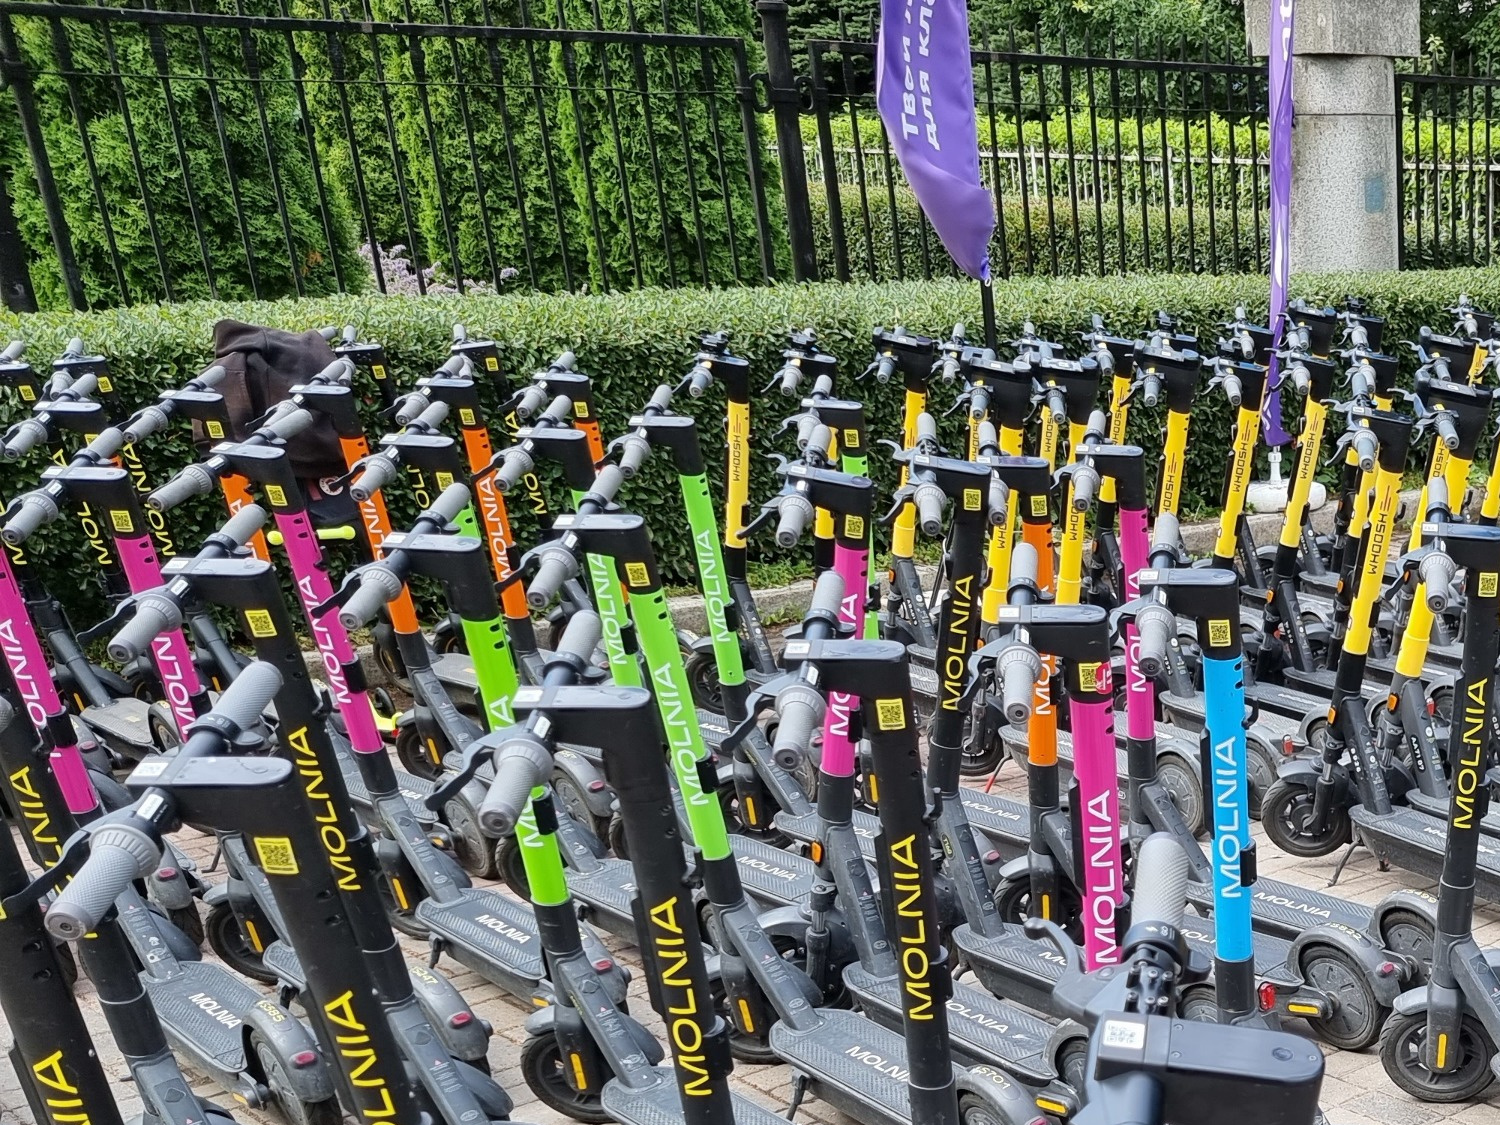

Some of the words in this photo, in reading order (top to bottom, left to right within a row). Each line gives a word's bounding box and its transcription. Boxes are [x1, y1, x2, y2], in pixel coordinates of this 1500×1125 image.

[919, 71, 941, 151] для
[52, 449, 112, 565] MOLA
[123, 443, 176, 556] MONIA
[733, 435, 742, 481] WHOOSH
[1233, 442, 1250, 493] WHOOSH
[1300, 433, 1316, 479] WHOOSH
[490, 477, 511, 580] MOLNIA
[1367, 513, 1388, 575] WHOOSH
[588, 552, 628, 666] MOLNIA
[697, 529, 731, 643] MOLNIA
[0, 618, 61, 757] OLNIA
[155, 636, 195, 736] MOLN
[943, 575, 974, 712] MOLNIA
[658, 662, 709, 806] MOLNIA
[1453, 678, 1488, 829] MOLNIA
[288, 726, 361, 891] MOLNIA
[962, 800, 1020, 821] MOLNIA
[1213, 735, 1248, 898] MOLNIA
[737, 856, 798, 882] MOLNIA
[1088, 790, 1118, 963] MOLNIA
[1253, 891, 1332, 920] MOLNIA
[474, 914, 532, 945] MOLNIA
[890, 834, 934, 1021] MOLNIA
[188, 992, 244, 1030] MOLNIA
[650, 896, 712, 1097] MOLNIA
[943, 998, 1009, 1035] OLNIA
